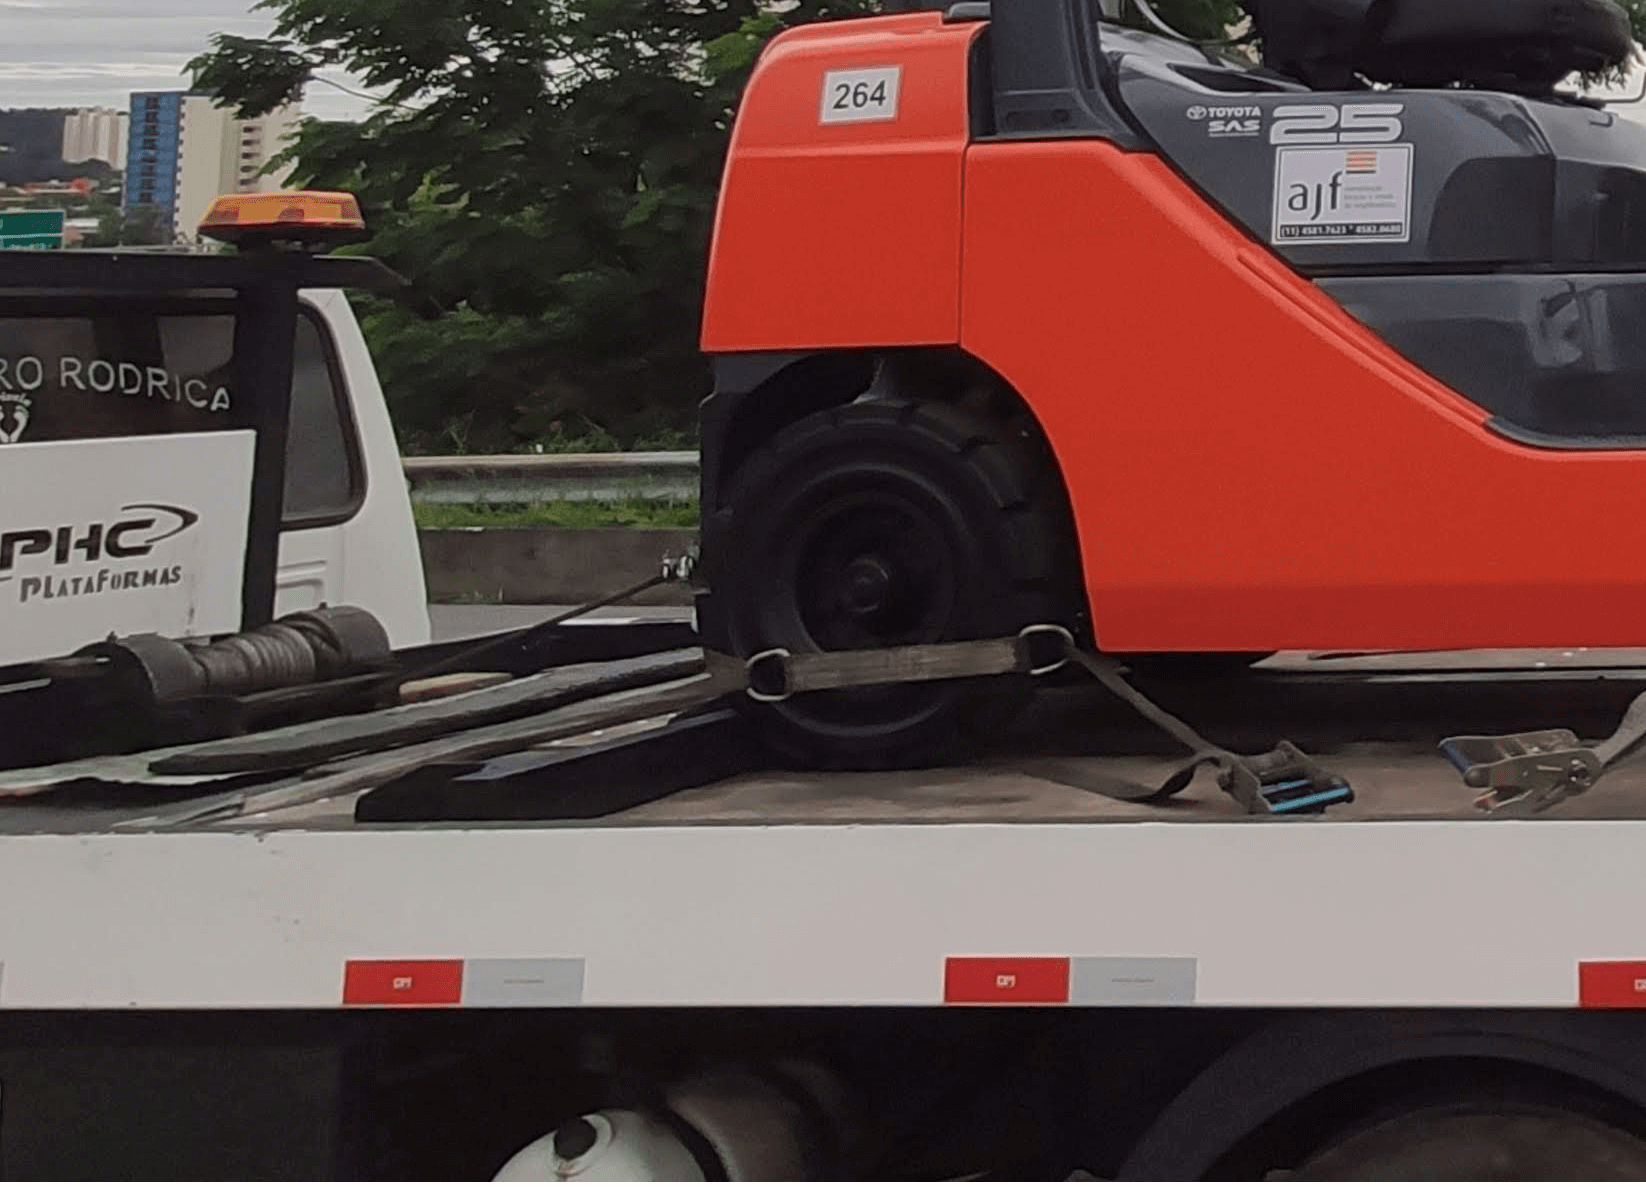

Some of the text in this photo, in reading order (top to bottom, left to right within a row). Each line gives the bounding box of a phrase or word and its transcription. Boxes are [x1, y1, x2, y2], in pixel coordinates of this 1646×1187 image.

[833, 79, 886, 109] 264
[1207, 103, 1404, 145] TOYOTA 25
[1207, 119, 1261, 133] SAS
[1287, 169, 1343, 222] ajf
[0, 516, 157, 571] PHC
